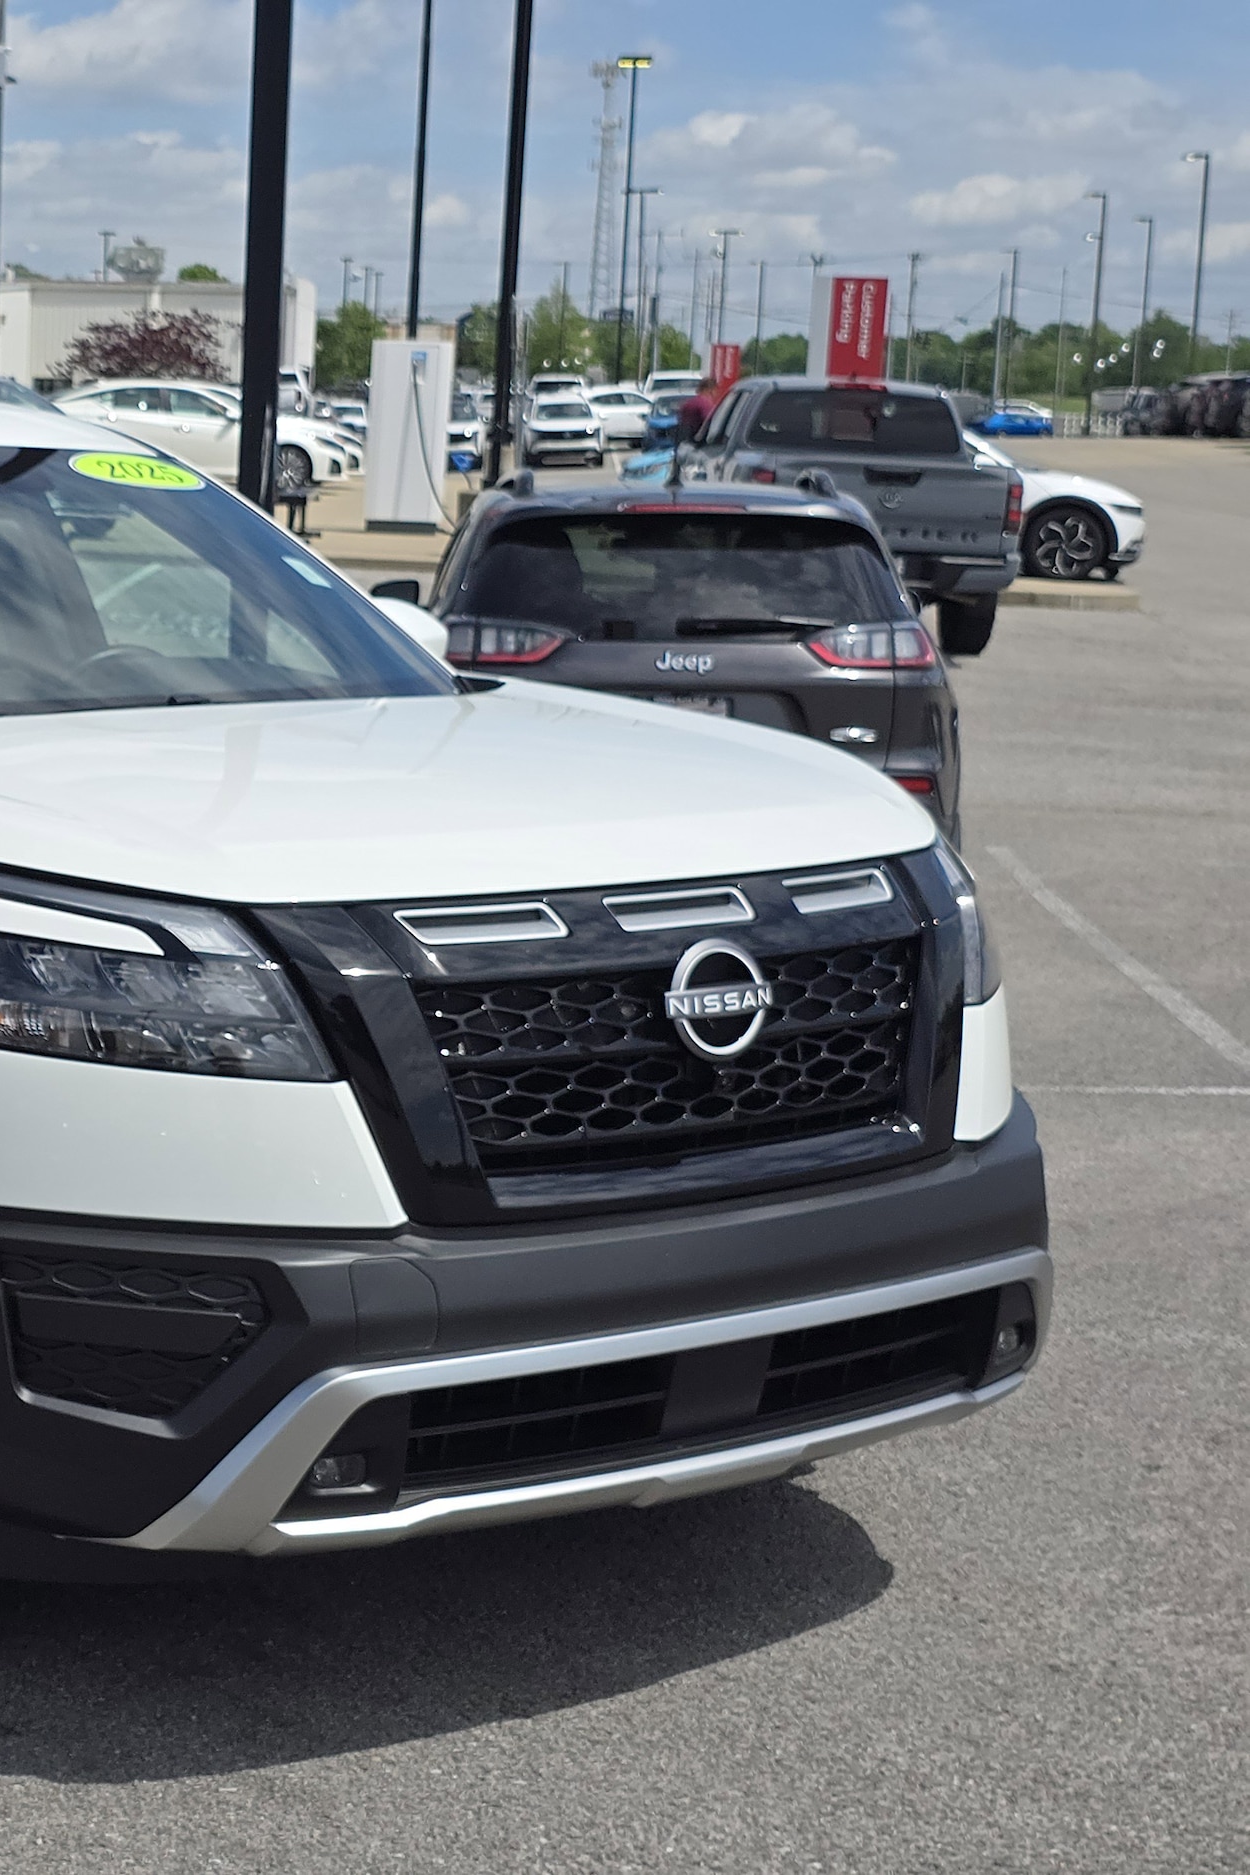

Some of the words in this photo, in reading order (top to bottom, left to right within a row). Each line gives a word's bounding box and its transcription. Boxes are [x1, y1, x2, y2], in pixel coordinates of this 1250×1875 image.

[835, 281, 856, 343] Parking
[857, 281, 876, 360] Customer
[96, 460, 184, 483] 2025
[654, 650, 715, 676] Jeep
[668, 987, 772, 1016] NISSAN
